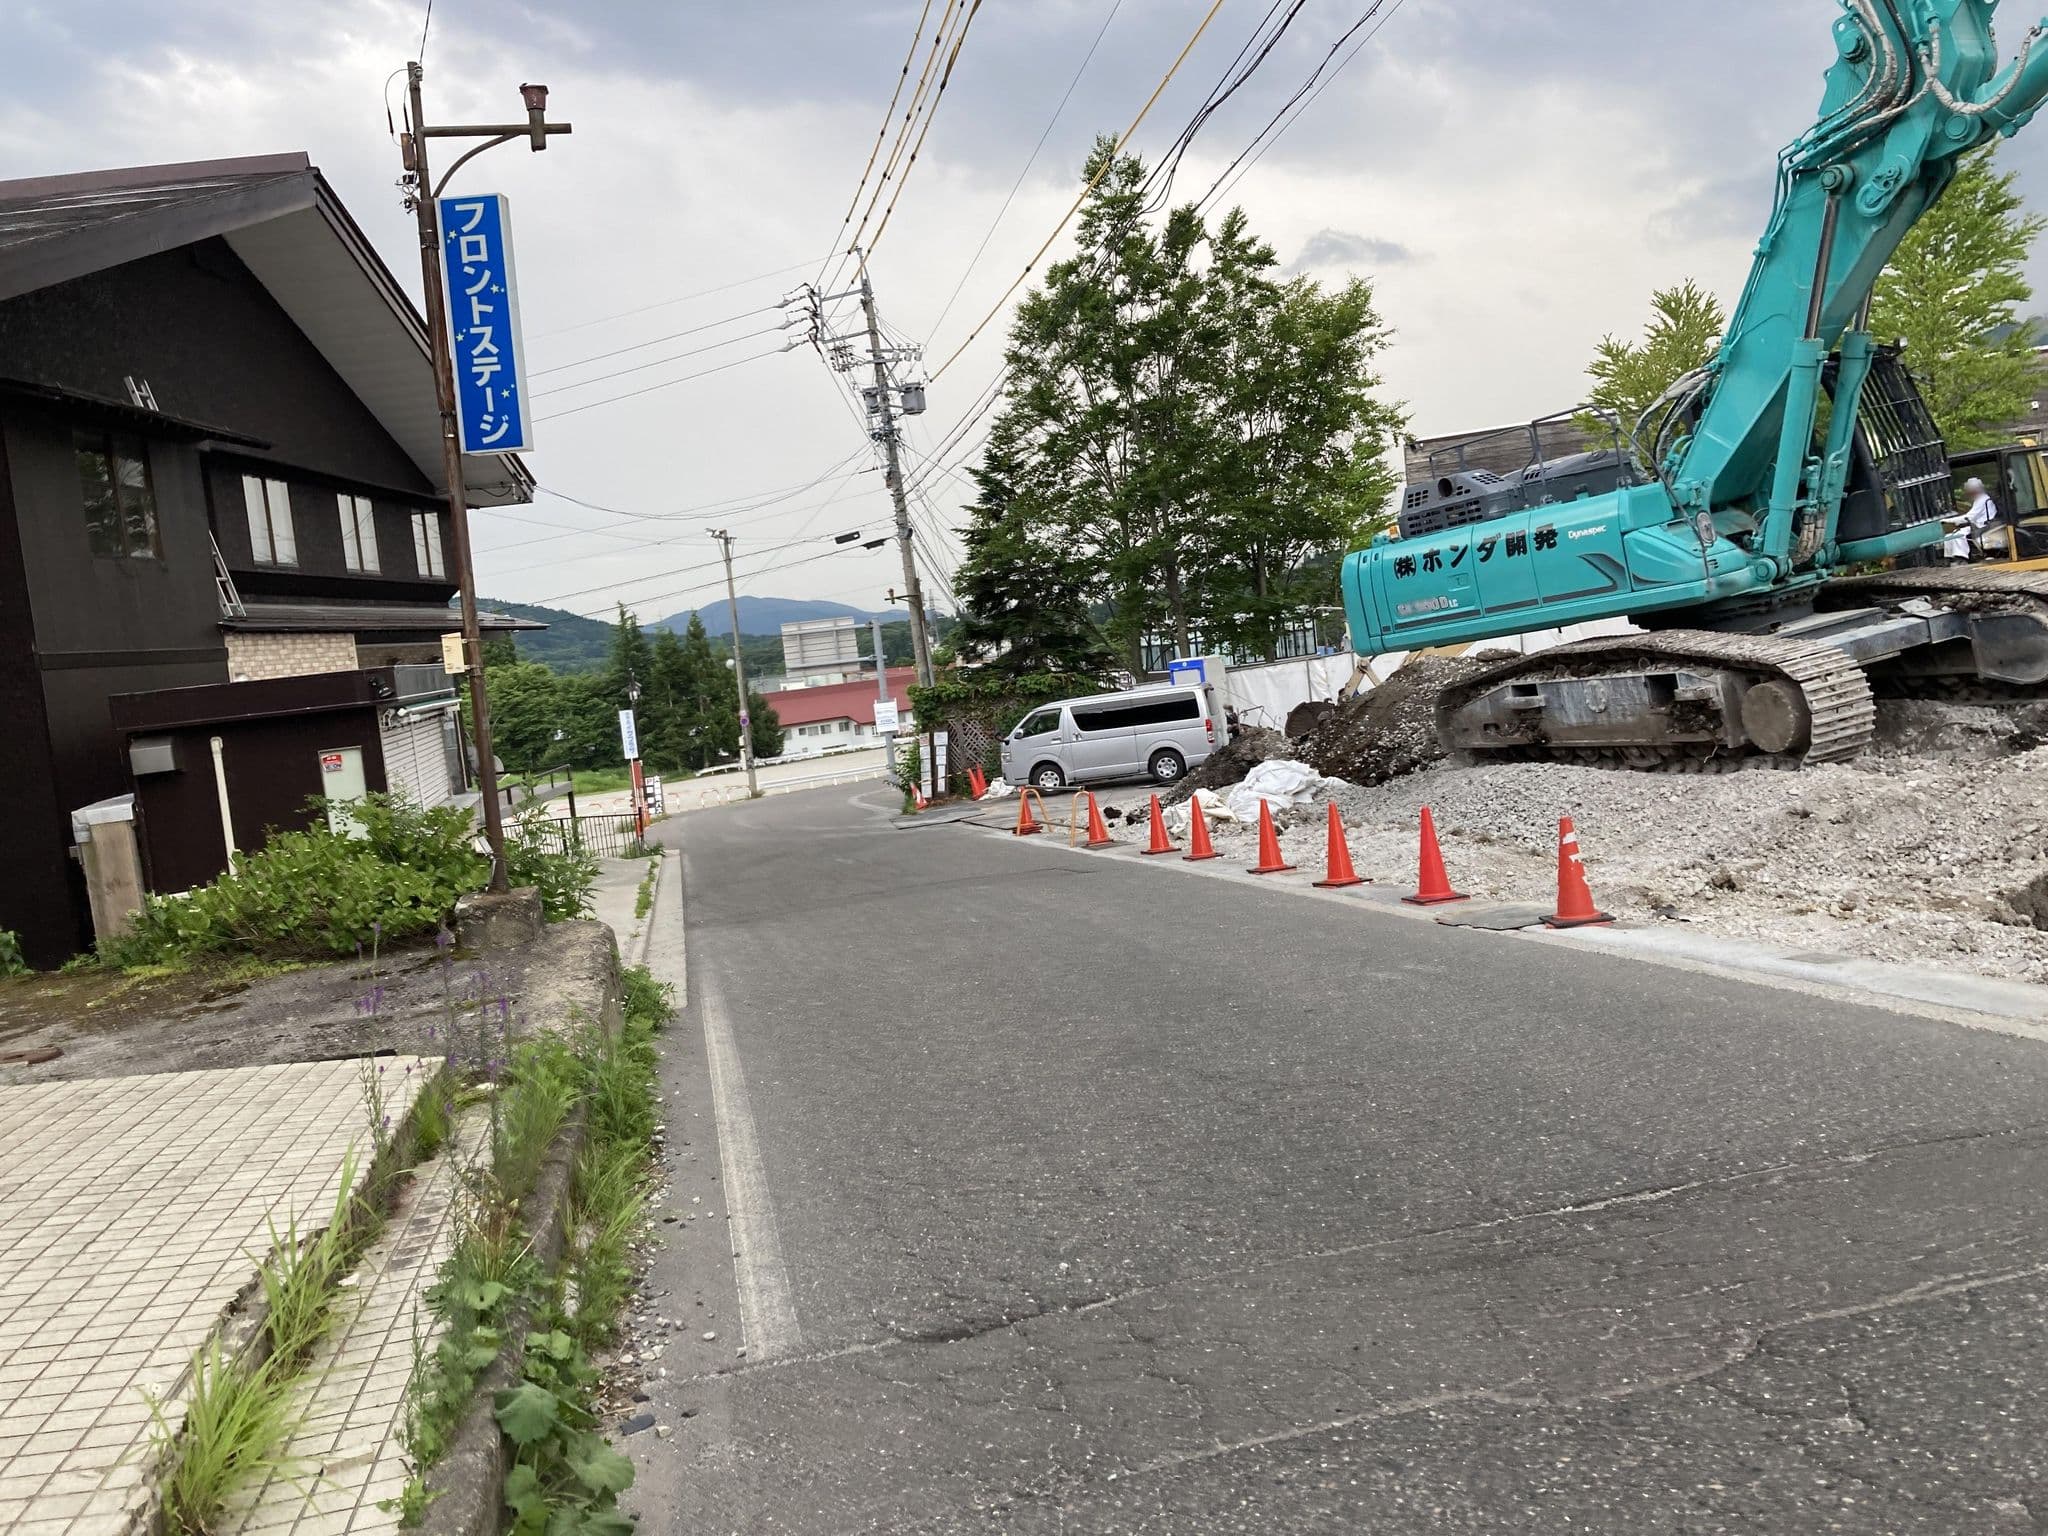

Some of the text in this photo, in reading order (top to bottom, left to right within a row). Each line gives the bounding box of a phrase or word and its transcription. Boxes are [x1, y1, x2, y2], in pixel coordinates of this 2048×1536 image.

[455, 202, 509, 444] フロントステージ
[1568, 525, 1608, 541] Dynaspec
